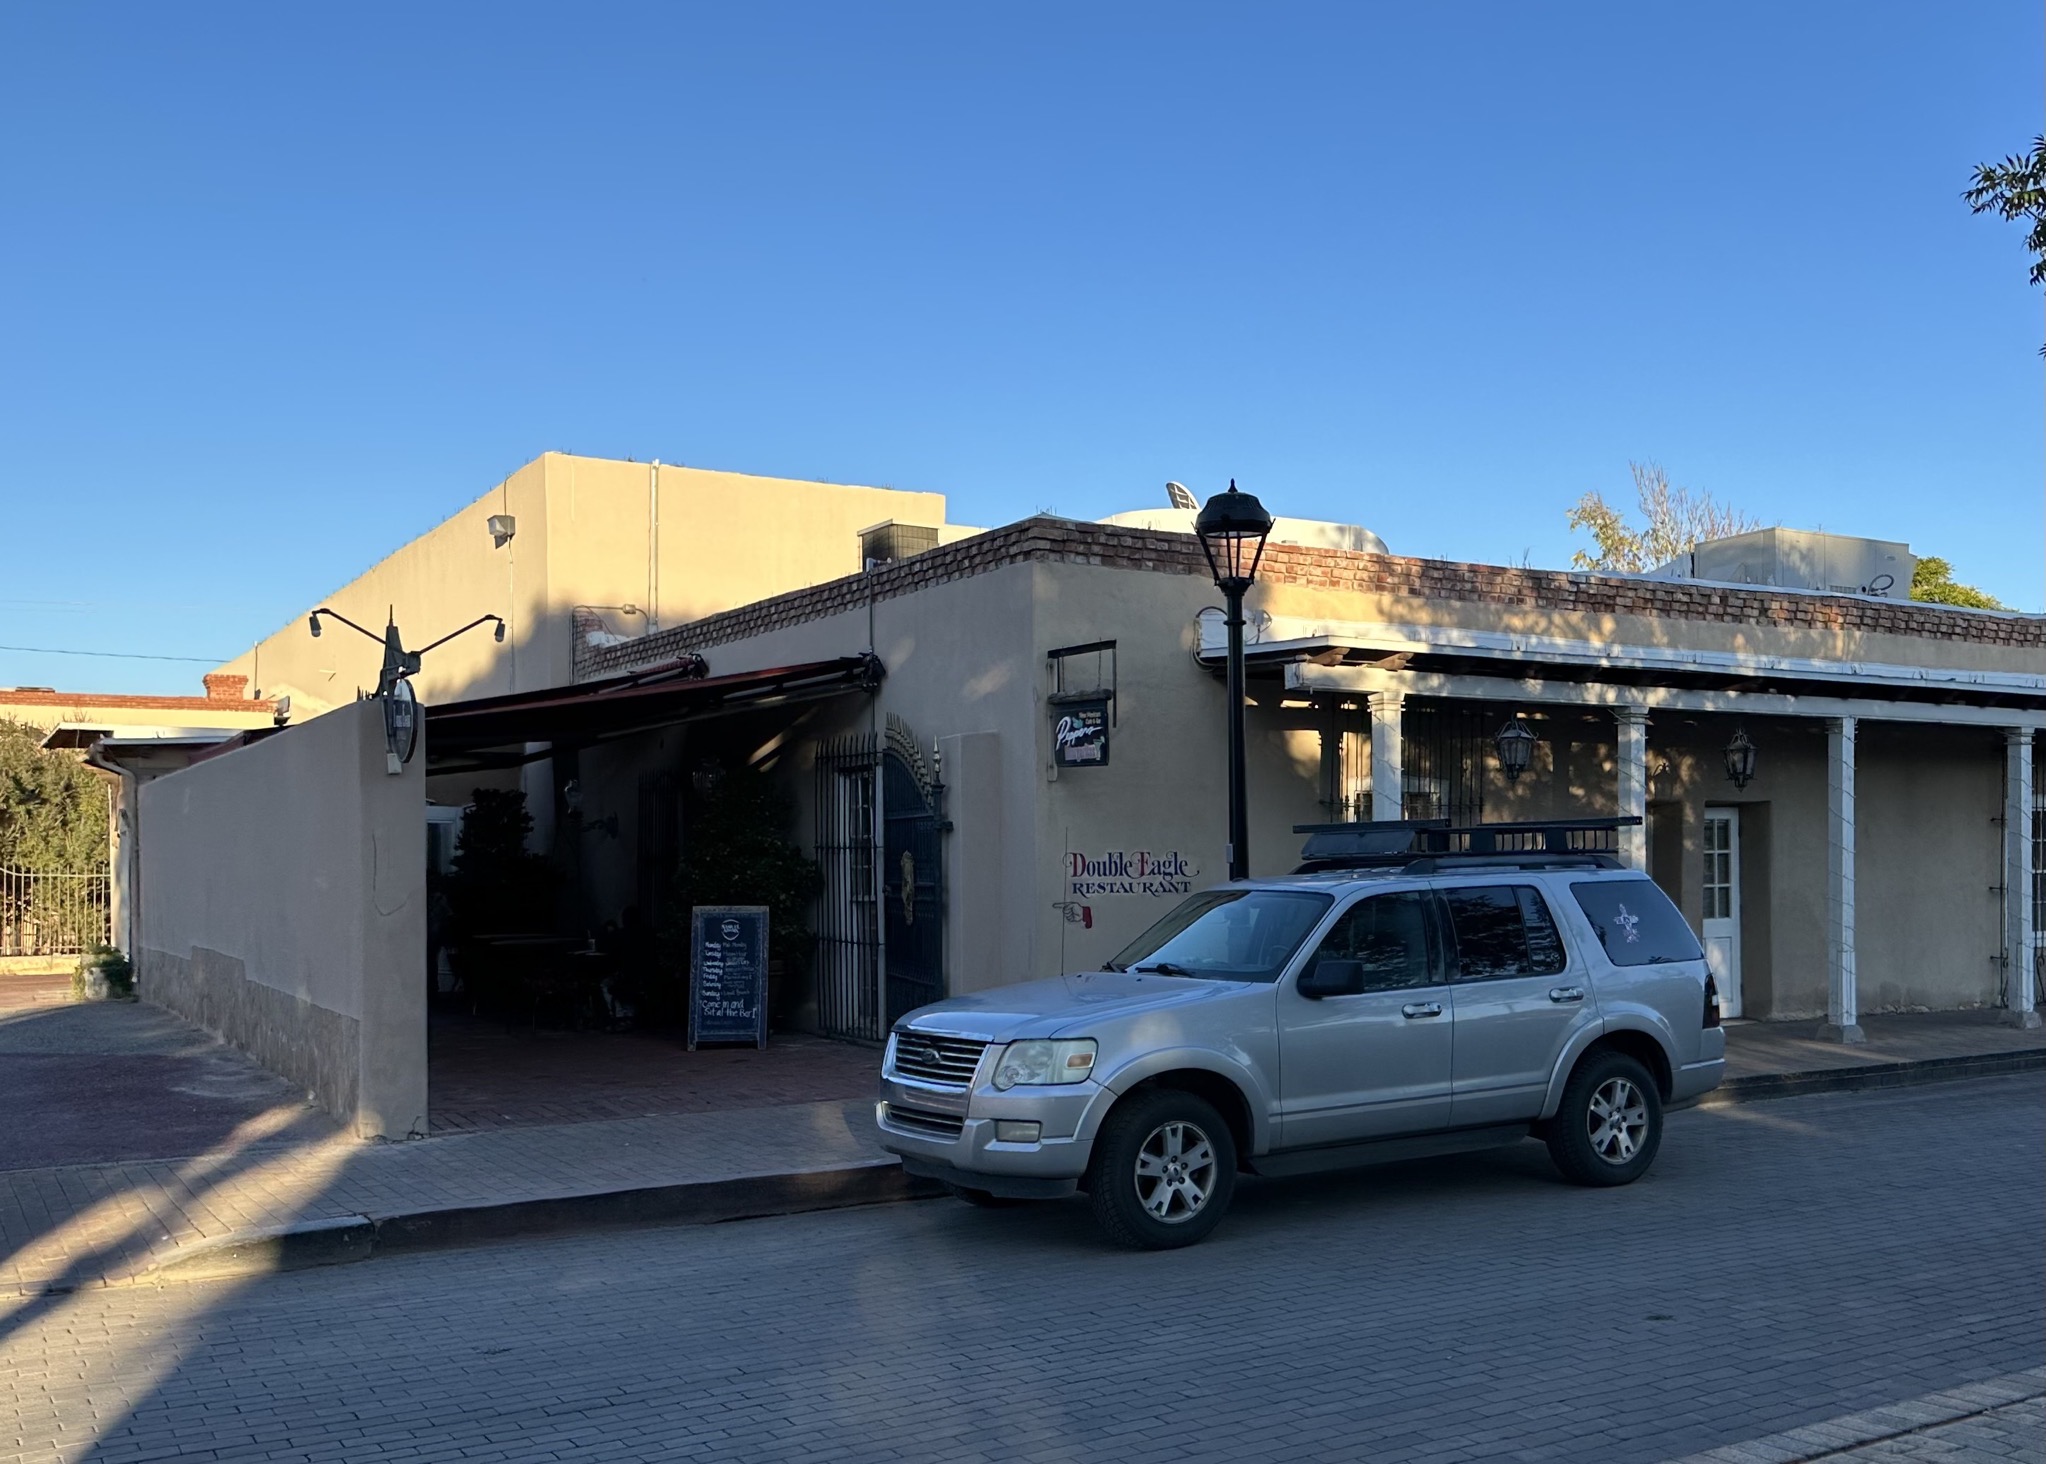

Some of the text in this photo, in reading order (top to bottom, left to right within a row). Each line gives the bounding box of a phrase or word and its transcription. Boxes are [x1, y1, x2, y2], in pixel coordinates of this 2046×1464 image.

[1055, 716, 1103, 751] Peppers
[1063, 851, 1200, 884] Double Eagle
[1072, 881, 1191, 898] RESTAURANT
[702, 1000, 722, 1009] Come
[731, 998, 745, 1009] and
[703, 1007, 715, 1017] Sit
[716, 1007, 724, 1017] at
[725, 1007, 738, 1017] the
